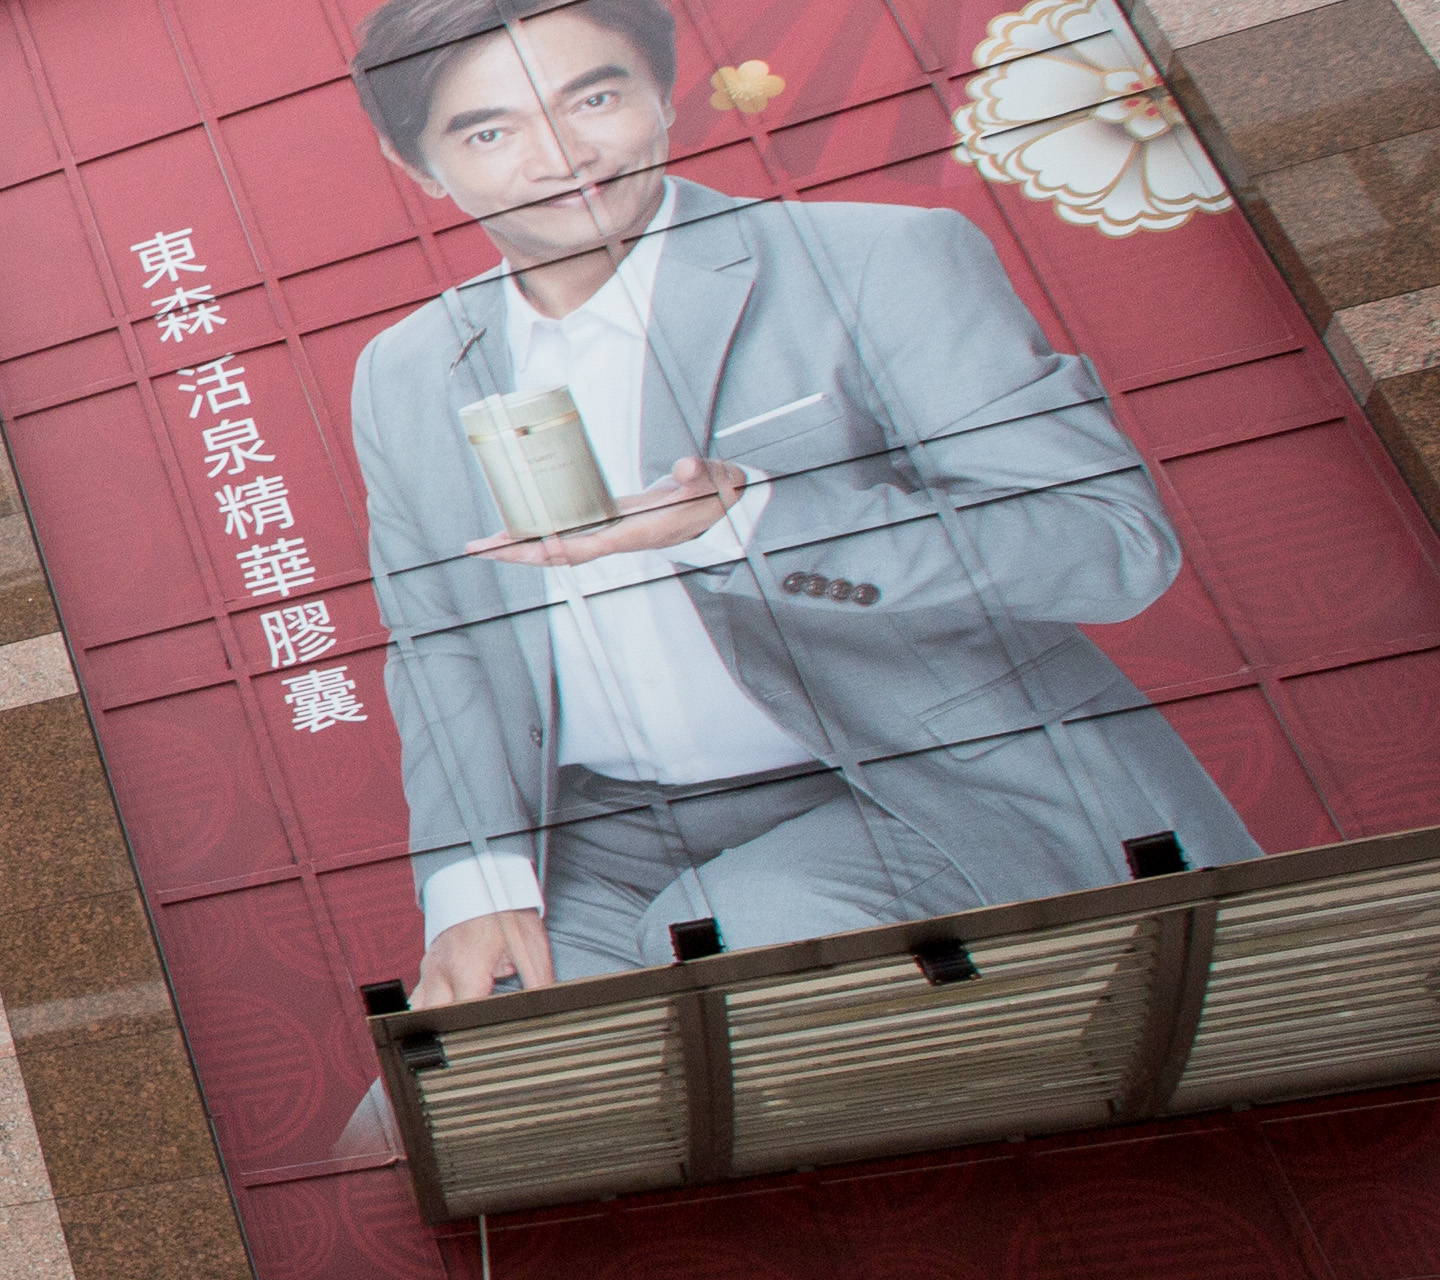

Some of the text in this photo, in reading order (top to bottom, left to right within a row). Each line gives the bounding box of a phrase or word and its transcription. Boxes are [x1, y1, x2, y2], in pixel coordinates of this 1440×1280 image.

[130, 227, 368, 734] 東森 活泉精華膠囊
